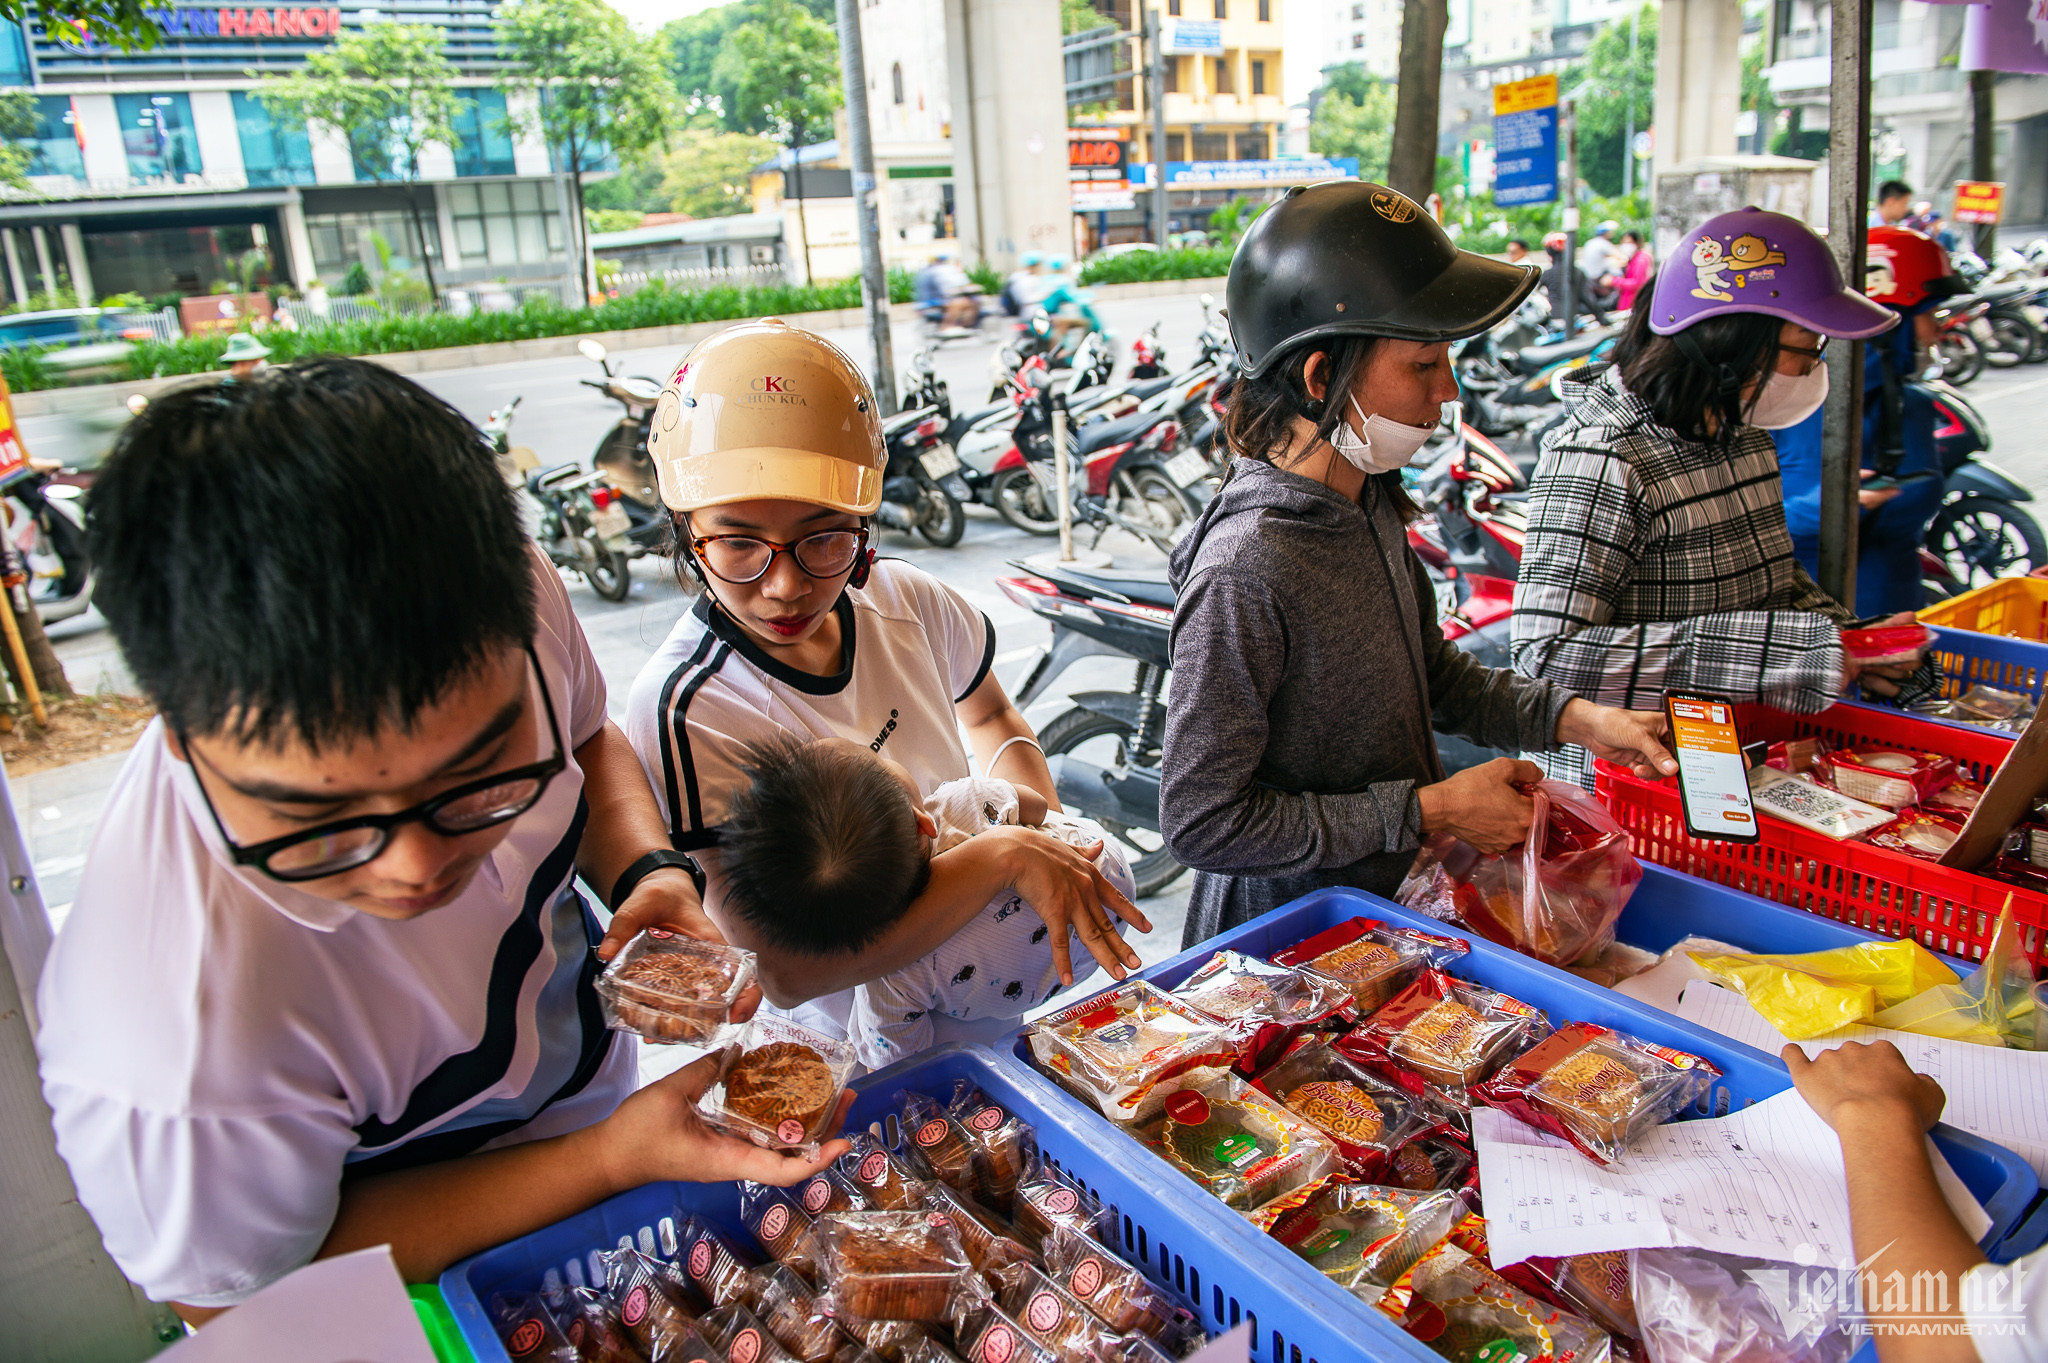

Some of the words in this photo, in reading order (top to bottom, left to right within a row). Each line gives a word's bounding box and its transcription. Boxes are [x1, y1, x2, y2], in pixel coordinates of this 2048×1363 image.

[146, 8, 340, 37] VNHANOI
[1069, 141, 1121, 166] ADIO
[750, 376, 795, 392] CKC
